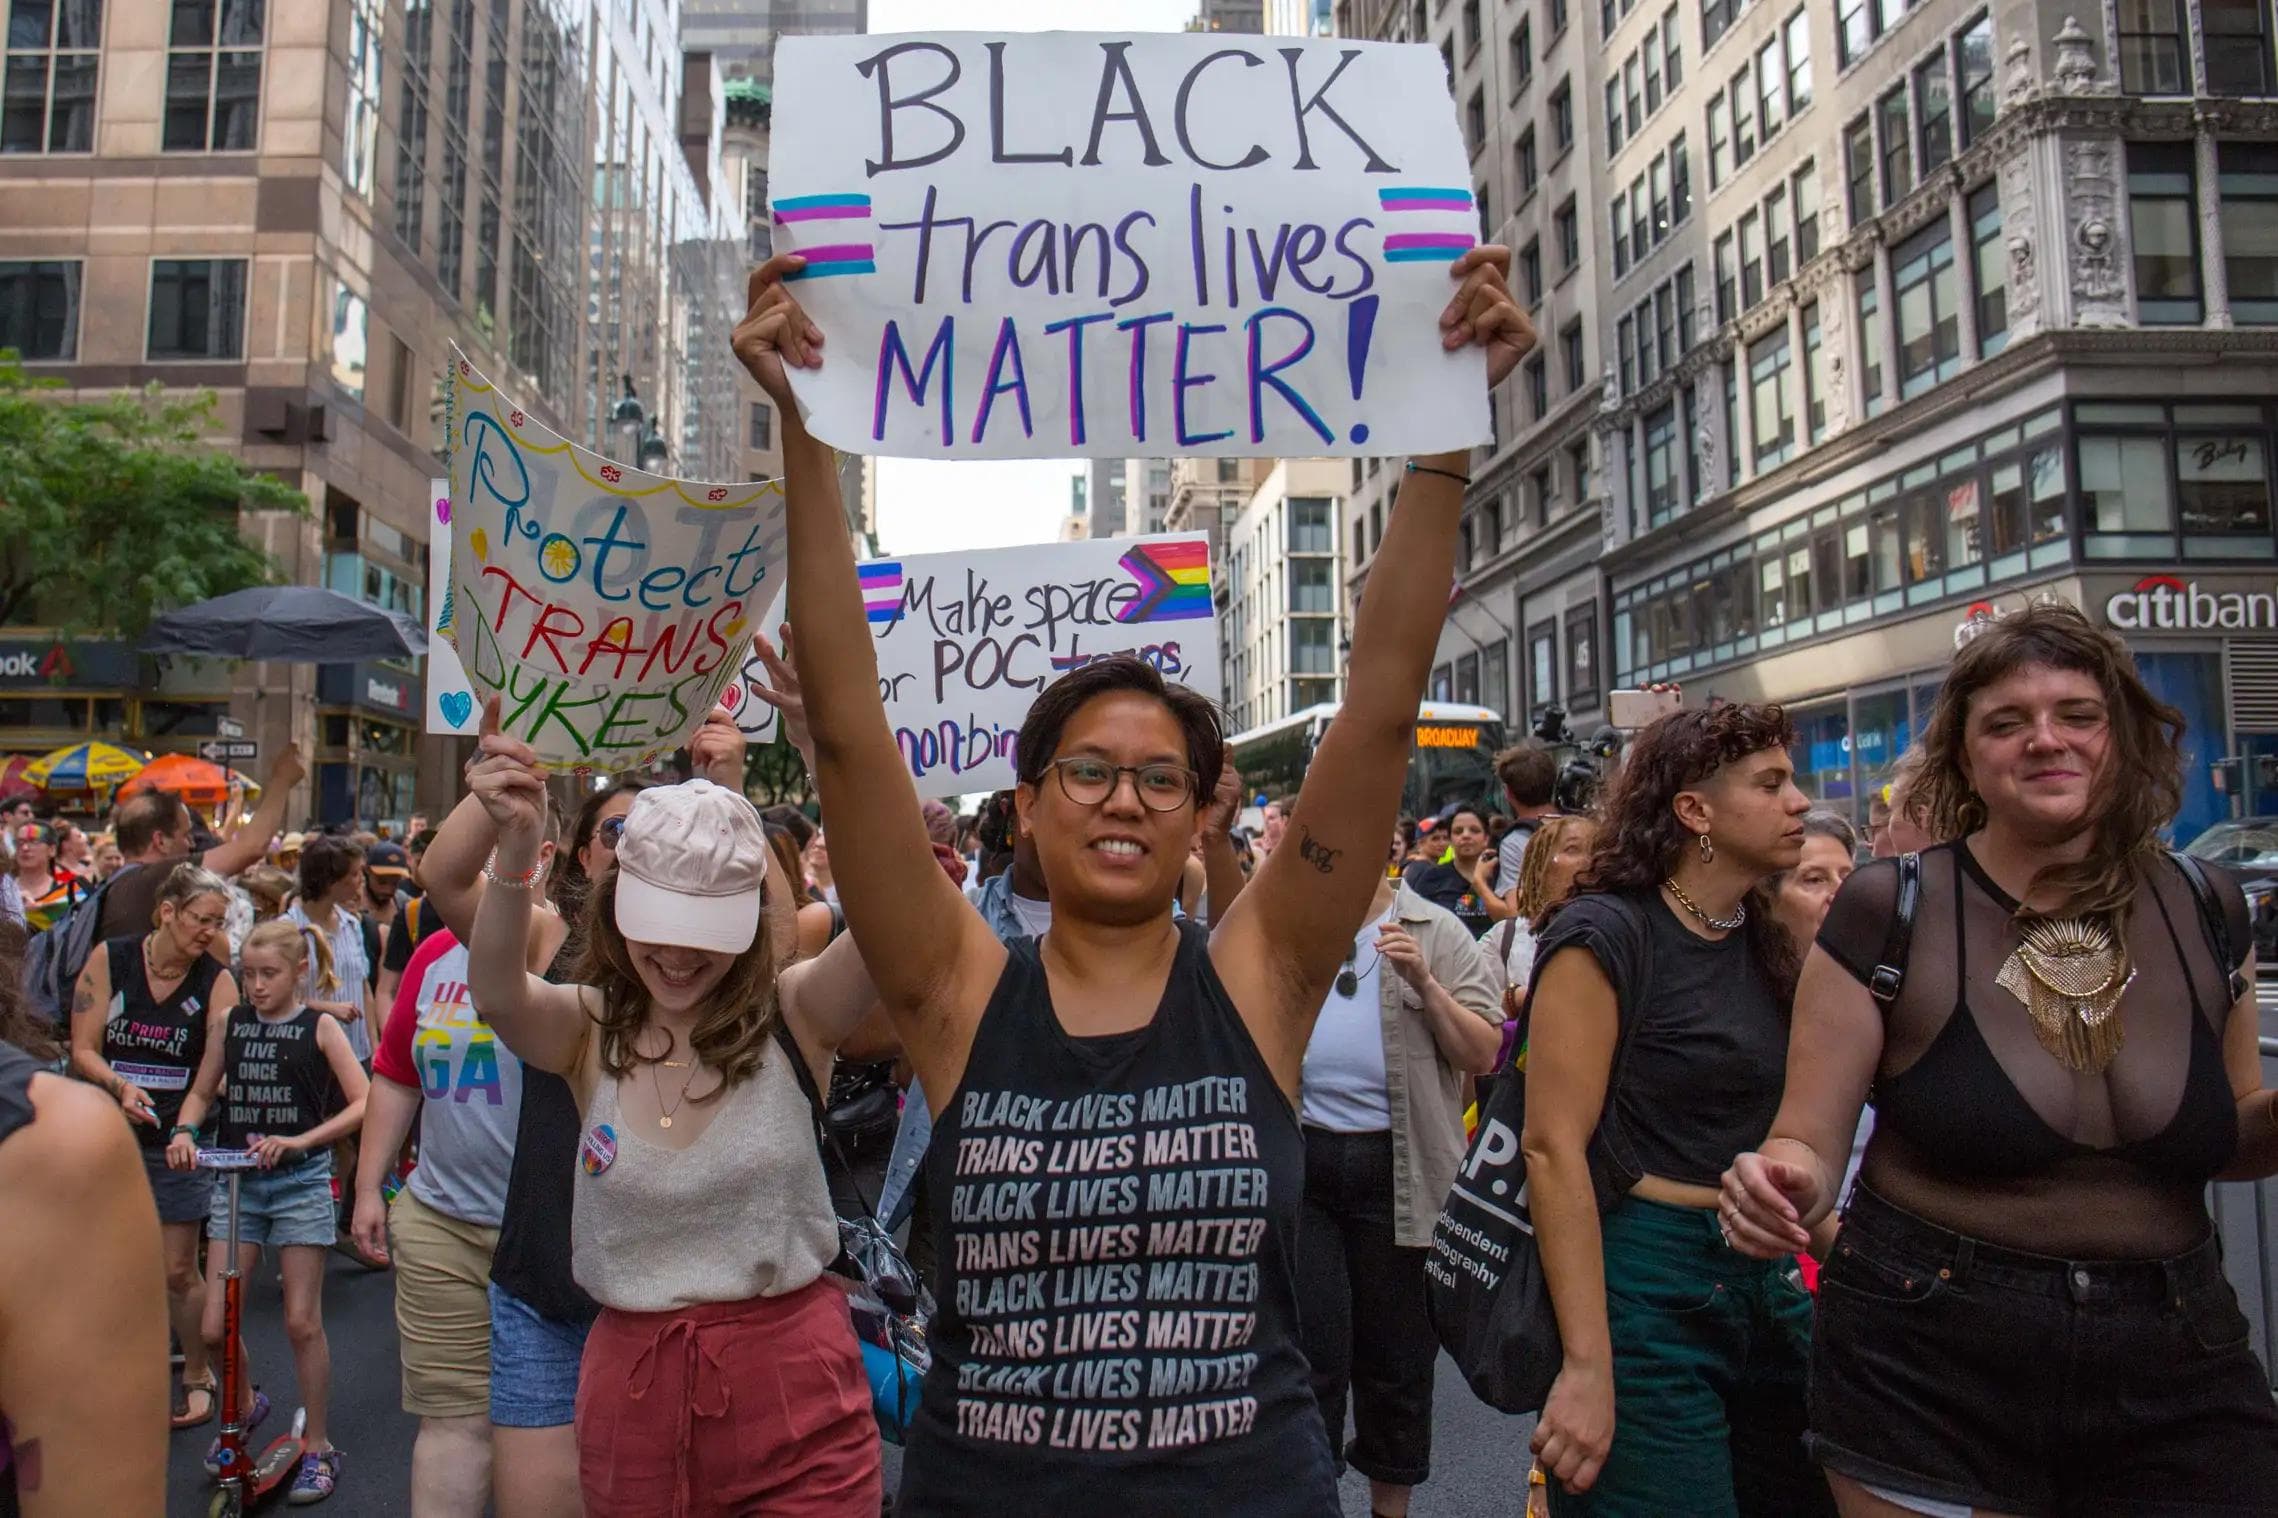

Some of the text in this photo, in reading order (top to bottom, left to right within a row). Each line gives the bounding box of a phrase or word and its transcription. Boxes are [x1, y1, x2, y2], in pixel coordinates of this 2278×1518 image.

[854, 40, 1401, 178] BLACK
[879, 182, 1376, 308] trans lives
[871, 294, 1381, 448] MATTER!
[464, 411, 766, 611] Protect
[481, 565, 742, 682] TRANS
[876, 568, 1143, 648] Make space
[2106, 579, 2278, 628] citiban
[0, 652, 38, 676] ok
[463, 585, 711, 757] DYKES
[878, 632, 1192, 704] or POC, tns,
[895, 713, 1019, 777] non-bin
[1416, 727, 1477, 748] BROADWAY
[106, 1029, 183, 1057] POLITICAL
[129, 1021, 172, 1040] PRIDE
[174, 1027, 188, 1042] IS
[232, 1021, 305, 1040] YOU ONLY
[243, 1041, 278, 1059] LIVE
[238, 1062, 278, 1080] ONCE
[247, 1086, 292, 1103] MAKE
[415, 1028, 504, 1107] GA
[266, 1107, 298, 1124] FUN
[961, 1075, 1247, 1132] BLACK LIVES MATTER
[955, 1122, 1259, 1176] TRANS LIVES MATTER
[951, 1168, 1268, 1223] BLACK LIVES MATTER
[955, 1218, 1267, 1270] TRANS LIVES MATTER
[1440, 1208, 1509, 1262] dependent
[956, 1261, 1259, 1316] BLACK LIVES MATTER
[966, 1311, 1256, 1358] TRANS LIVES MATTER
[957, 1353, 1259, 1399] BLACK LIVES MATTER
[956, 1396, 1258, 1450] TRANS LIVES MATTER
